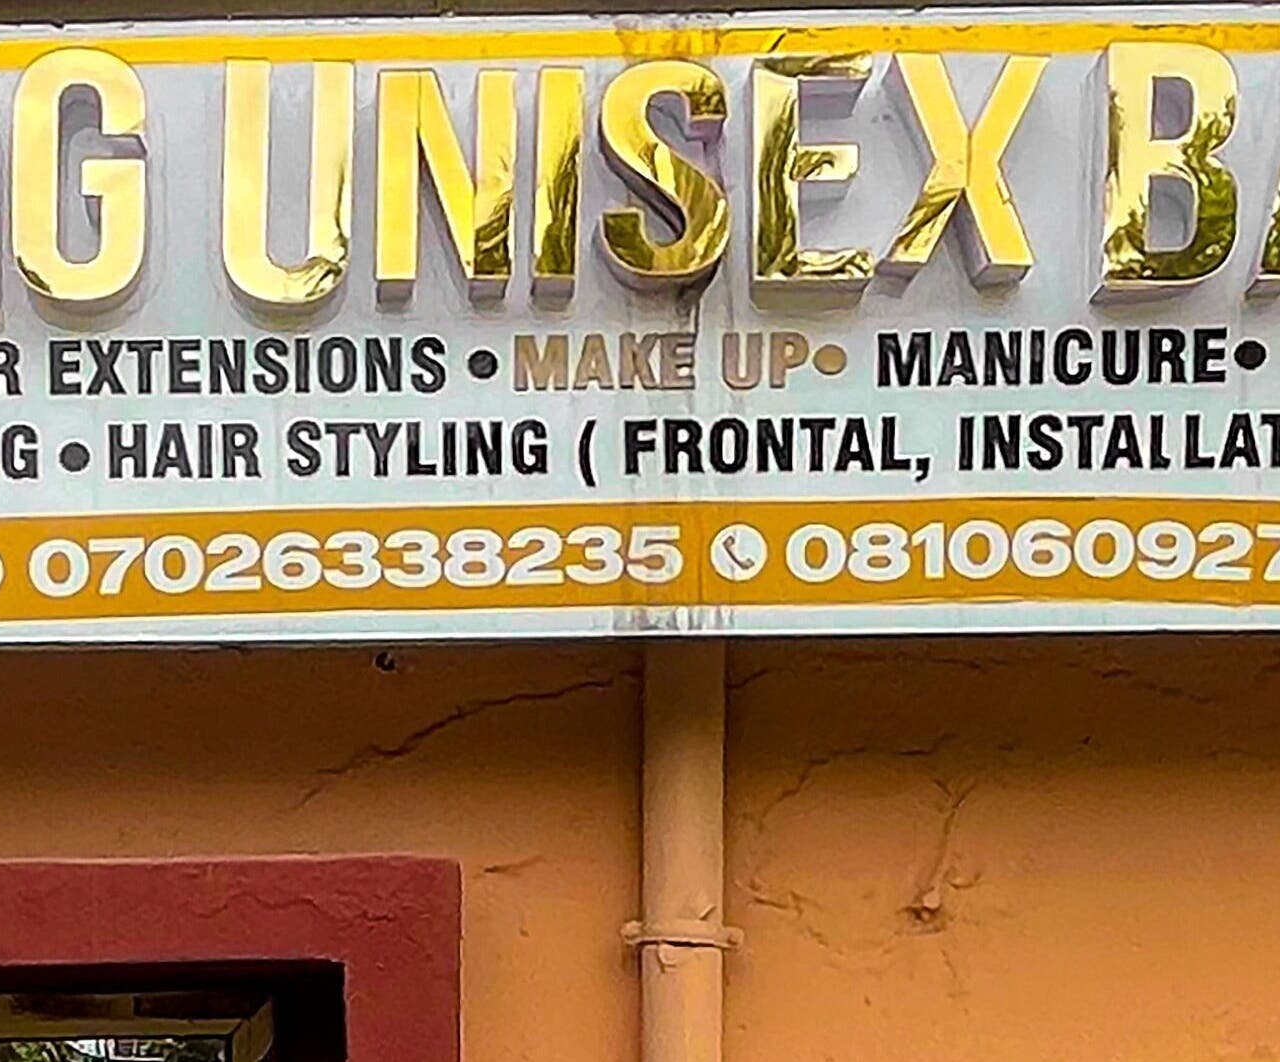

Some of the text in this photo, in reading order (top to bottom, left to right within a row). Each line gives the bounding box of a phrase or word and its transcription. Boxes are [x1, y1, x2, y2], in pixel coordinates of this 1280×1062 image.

[222, 50, 1048, 308] UNISEX
[48, 336, 447, 397] EXTENSIONS
[513, 331, 696, 392] MAKE
[721, 334, 810, 390] UP
[876, 328, 1227, 388] MANICURE
[107, 421, 262, 480] HAIR
[286, 419, 549, 479] STYLING
[623, 414, 931, 483] FRONTAL,
[28, 525, 683, 596] 07026338235
